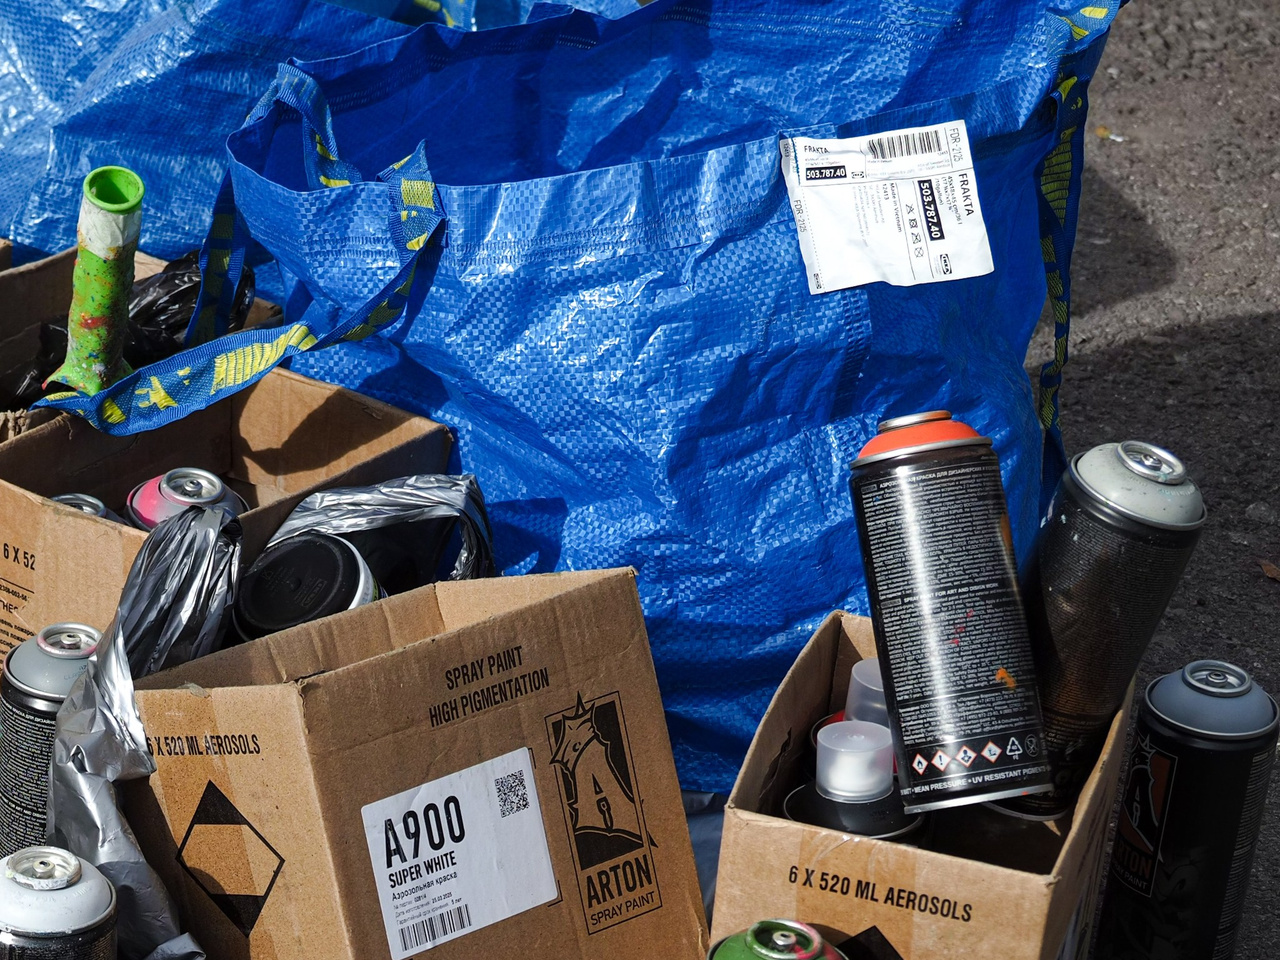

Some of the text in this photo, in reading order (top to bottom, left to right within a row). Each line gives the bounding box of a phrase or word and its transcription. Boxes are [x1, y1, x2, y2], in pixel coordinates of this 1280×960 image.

[804, 145, 830, 154] FRAKTA
[806, 168, 845, 179] 503.787.40
[920, 181, 941, 239] 503.787.40
[959, 173, 974, 216] FRAKTA
[894, 207, 902, 233] Vietnam
[941, 254, 951, 274] IKEA
[3, 543, 10, 560] 6
[12, 546, 20, 564] X
[444, 646, 523, 691] SPRAY PAINT
[428, 667, 550, 728] HIGH PIGMENTATION
[147, 734, 261, 756] 6 X 520 ML AEROSOLS
[930, 778, 968, 792] PRESSURE
[971, 775, 984, 784] UV
[984, 769, 1021, 782] RESISTANT
[384, 795, 466, 869] A900
[388, 851, 457, 889] SUPER WHITE
[392, 871, 458, 901] Аэрозольная краска
[585, 854, 653, 909] ARTON
[1125, 870, 1148, 890] PAINT
[590, 891, 656, 927] SPRAY PAINT
[788, 865, 973, 923] 6 X 520 ML AEROSOLS
